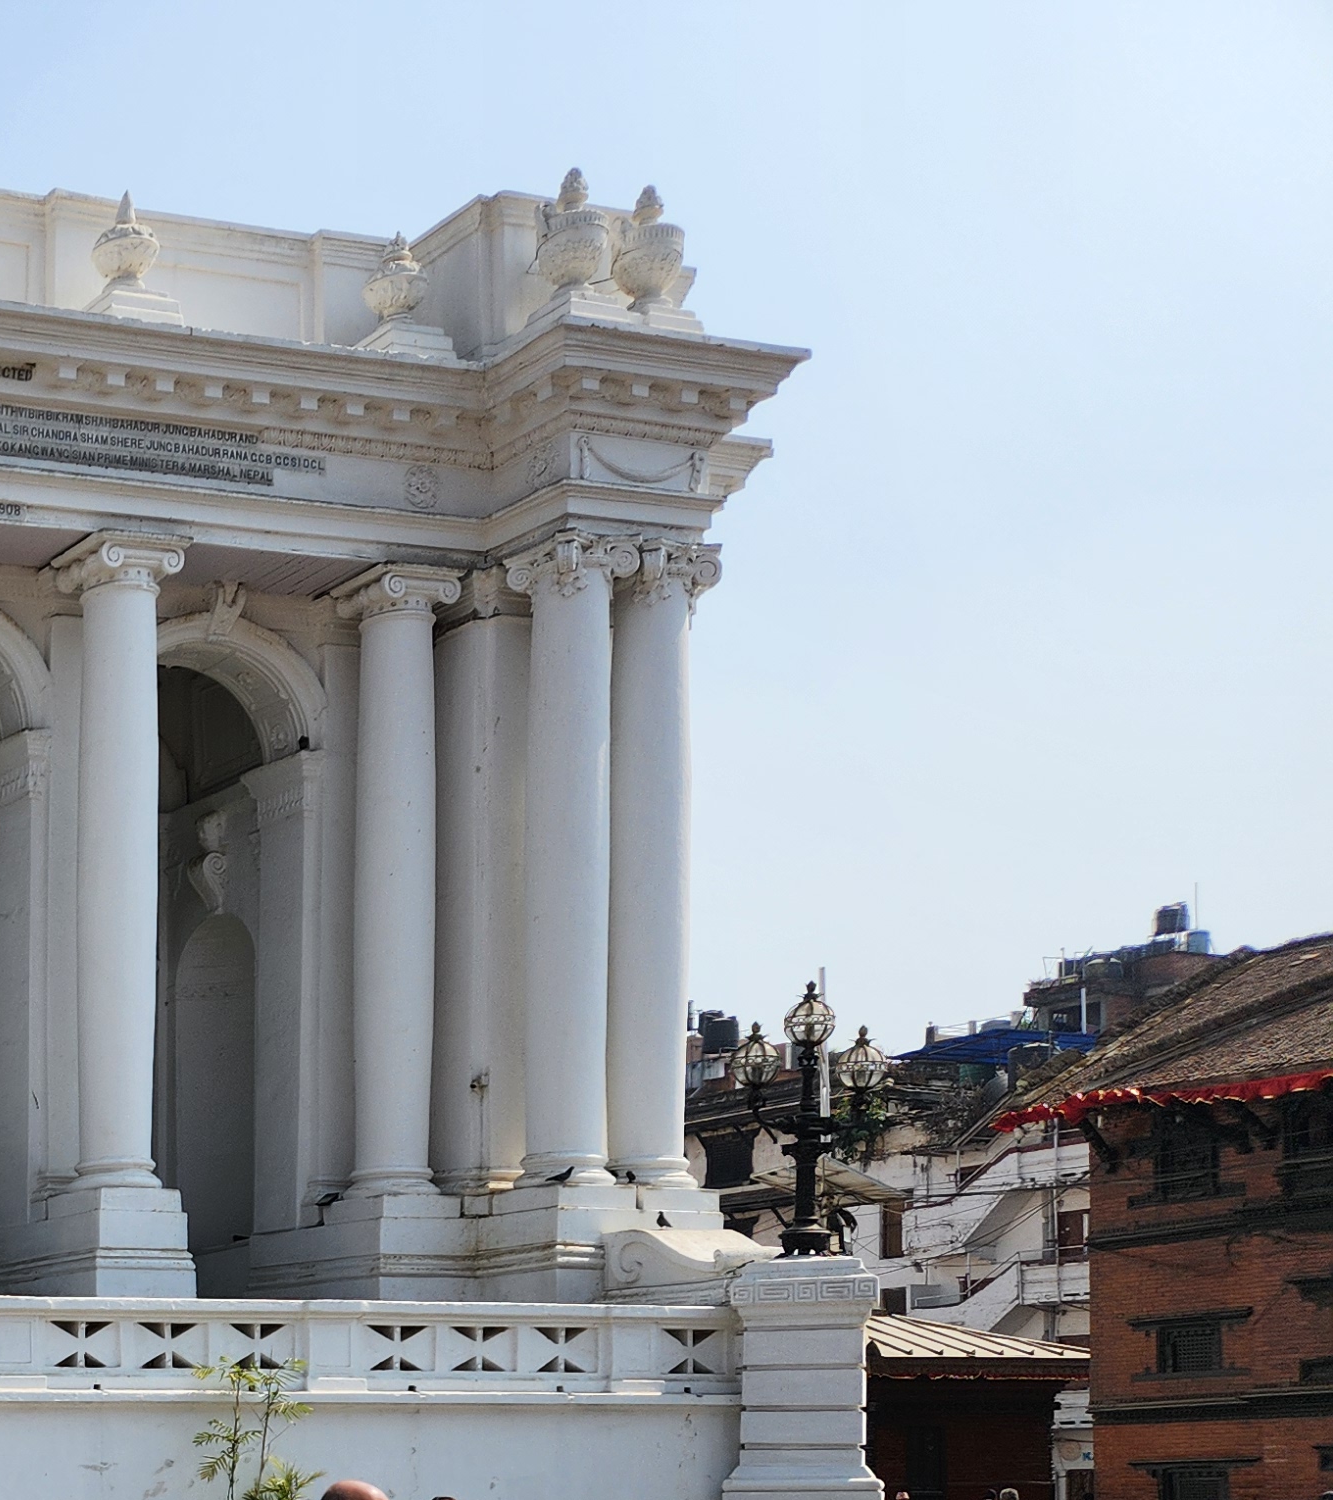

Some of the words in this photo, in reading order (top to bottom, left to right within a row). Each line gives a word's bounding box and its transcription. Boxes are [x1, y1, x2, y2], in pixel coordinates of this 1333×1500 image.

[46, 410, 83, 425] BIKRAM
[84, 415, 111, 429] SHAH
[112, 418, 160, 434] BAHADUR
[161, 423, 189, 437] JUNG
[189, 428, 237, 443] BAHADUR
[238, 433, 259, 445] AND
[12, 424, 29, 436] SIR
[30, 426, 79, 443] CHANDRA
[145, 440, 173, 453] JUNG
[173, 444, 221, 459] BAHADUR
[221, 449, 249, 462] RANA
[250, 452, 273, 465] GCB
[274, 455, 302, 468] GCSI
[303, 459, 326, 471] DCL
[71, 449, 95, 462] SIAN
[96, 452, 131, 466] PRIME
[131, 455, 179, 471] MINISTER
[239, 468, 274, 482] NEPAL
